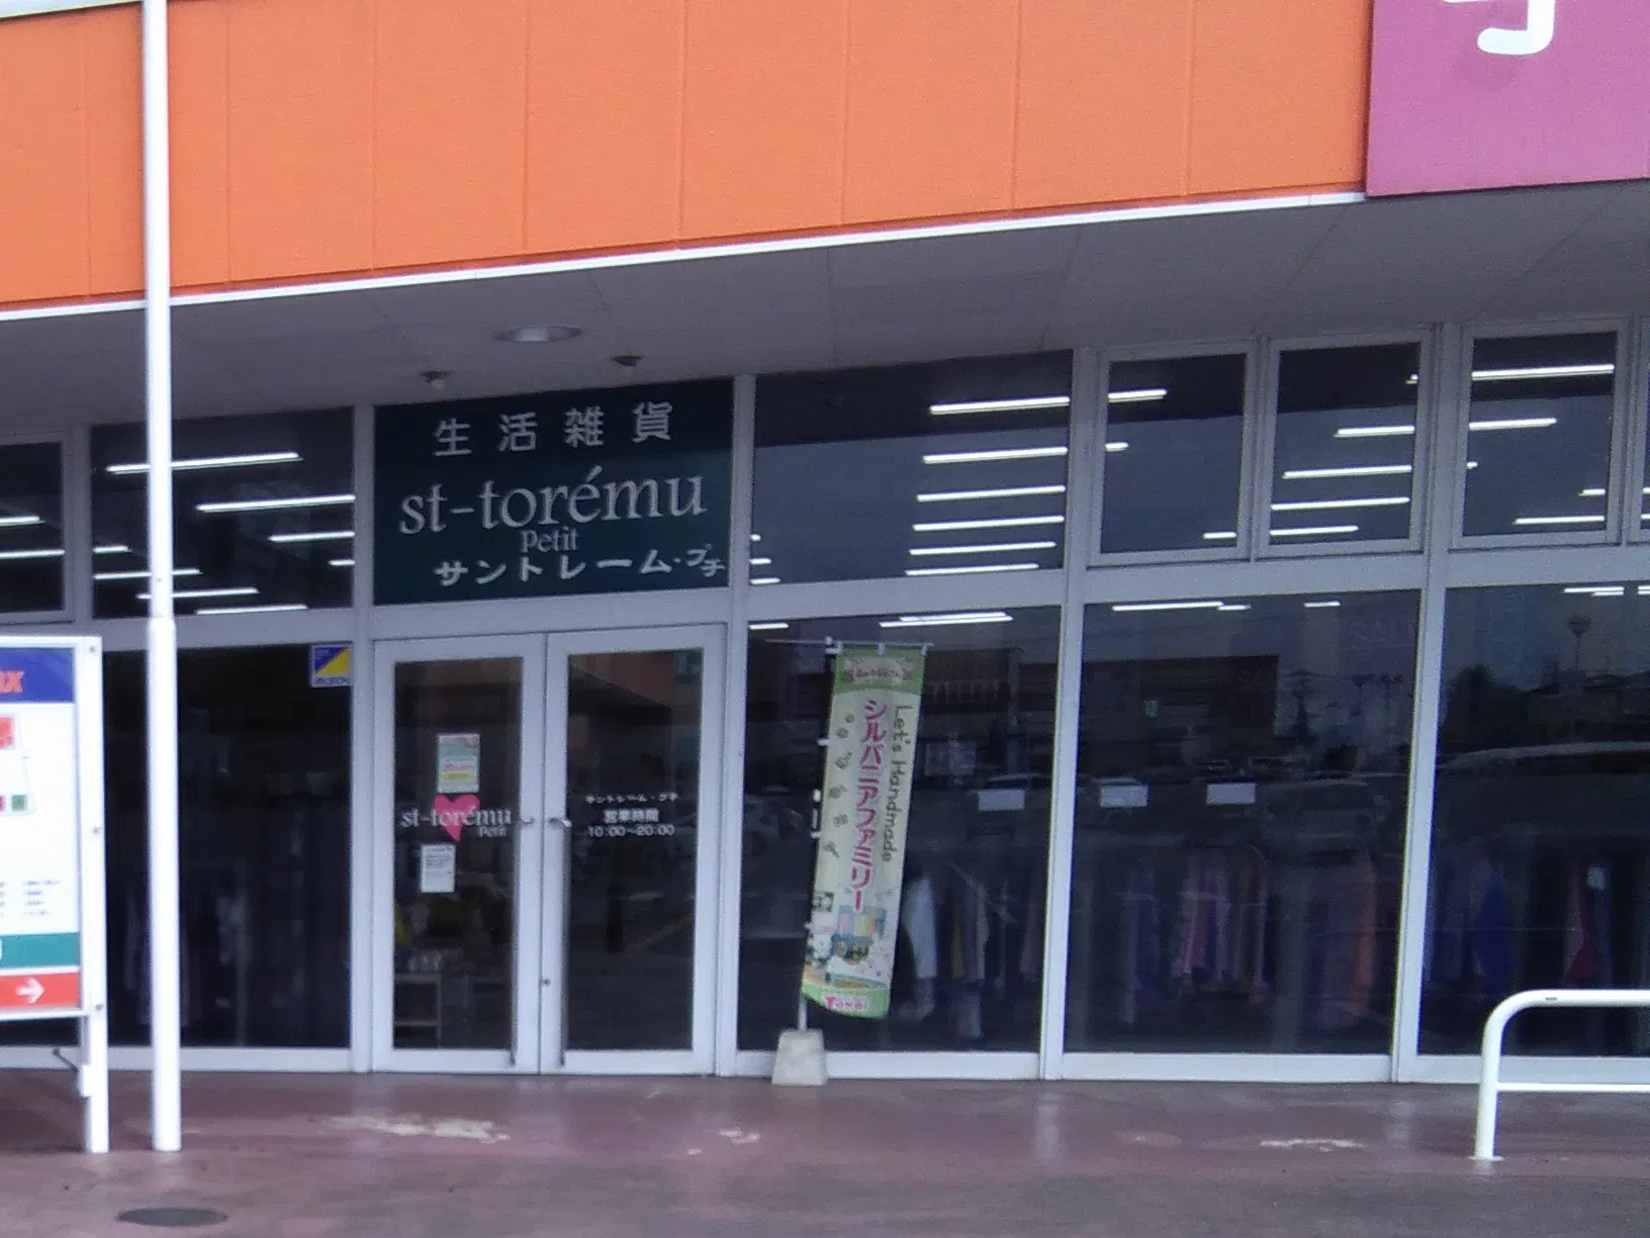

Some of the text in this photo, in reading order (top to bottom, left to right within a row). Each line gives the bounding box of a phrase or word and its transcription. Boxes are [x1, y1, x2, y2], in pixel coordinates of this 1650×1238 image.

[433, 401, 673, 457] 生活雑貨
[399, 465, 709, 535] st-torému
[521, 527, 579, 553] Petit
[849, 700, 888, 911] シルバニアファミリー
[882, 705, 914, 864] Let's Handmade
